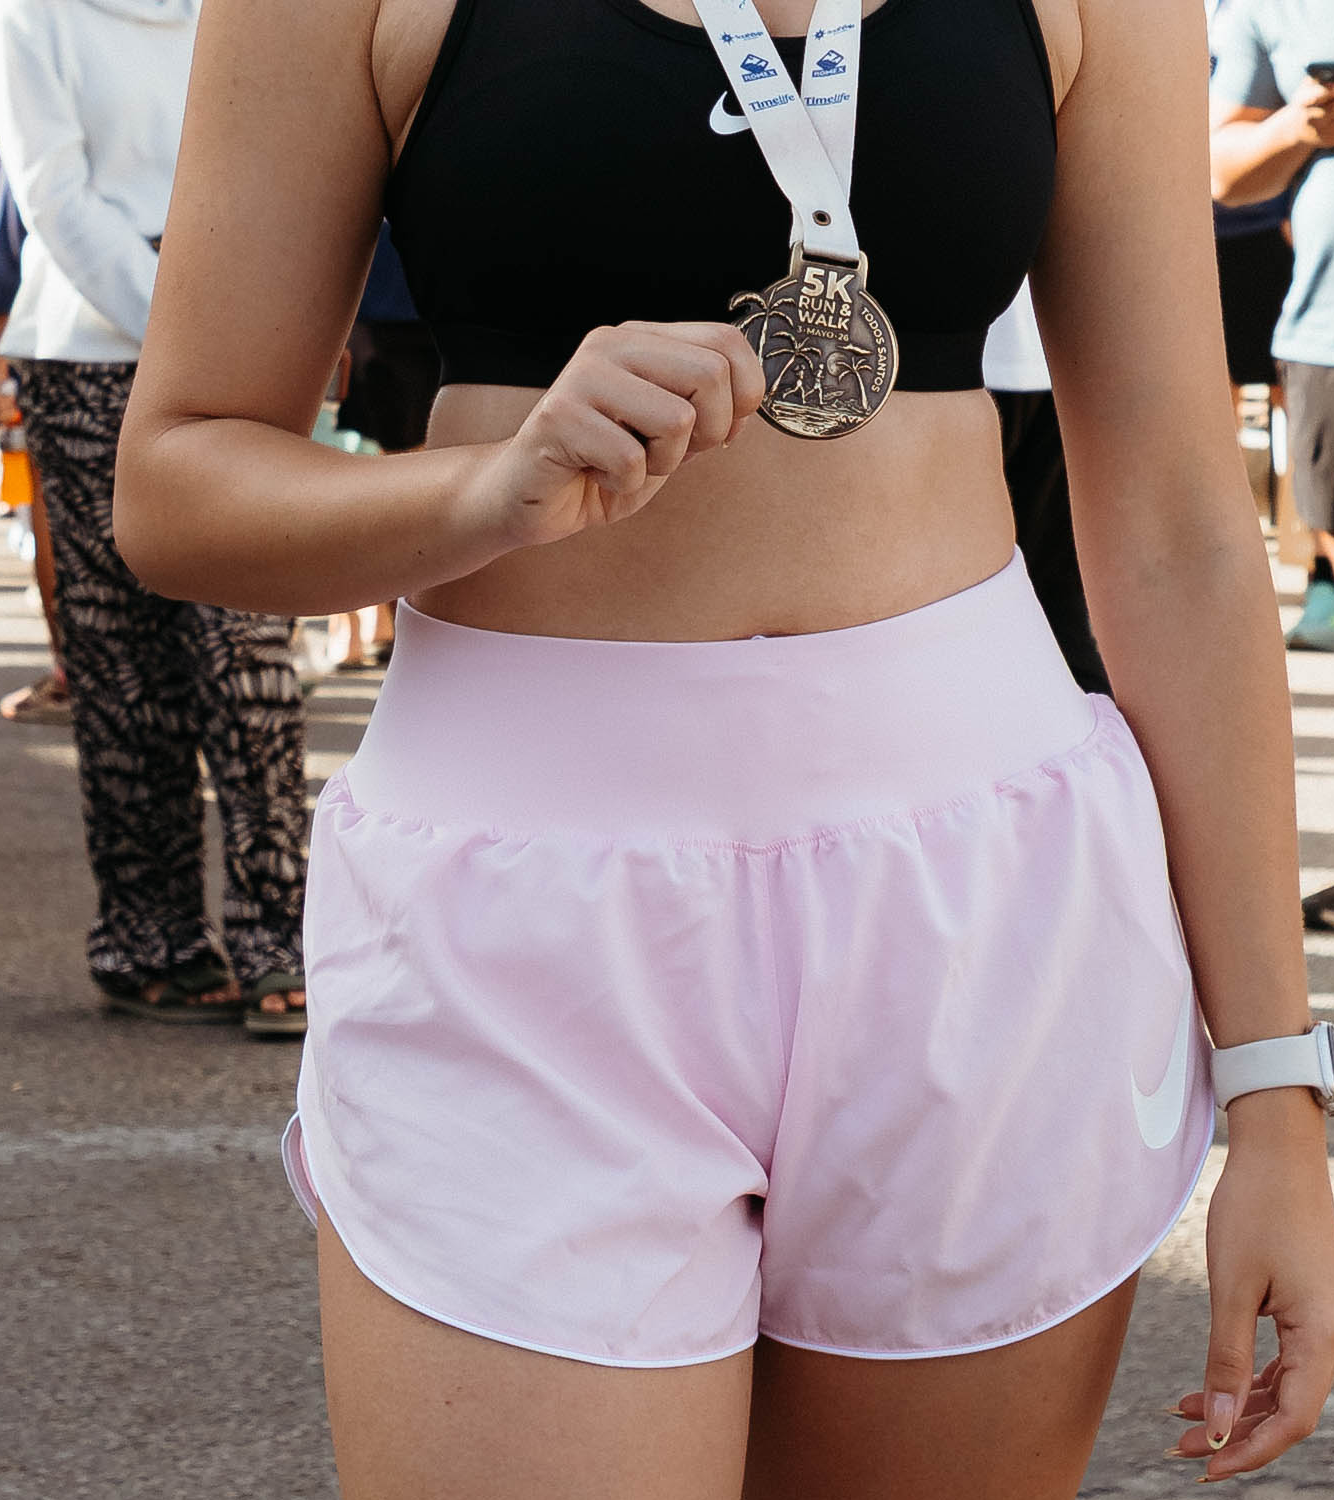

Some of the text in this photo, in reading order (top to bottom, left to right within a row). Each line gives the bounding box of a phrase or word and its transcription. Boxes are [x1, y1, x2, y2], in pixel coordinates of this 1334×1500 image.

[749, 93, 796, 112] Timelife
[804, 92, 851, 107] Timelife
[800, 266, 855, 304] 5K
[798, 295, 852, 317] RUN &
[798, 308, 850, 331] WALK
[861, 306, 888, 393] TODOS SANTOS
